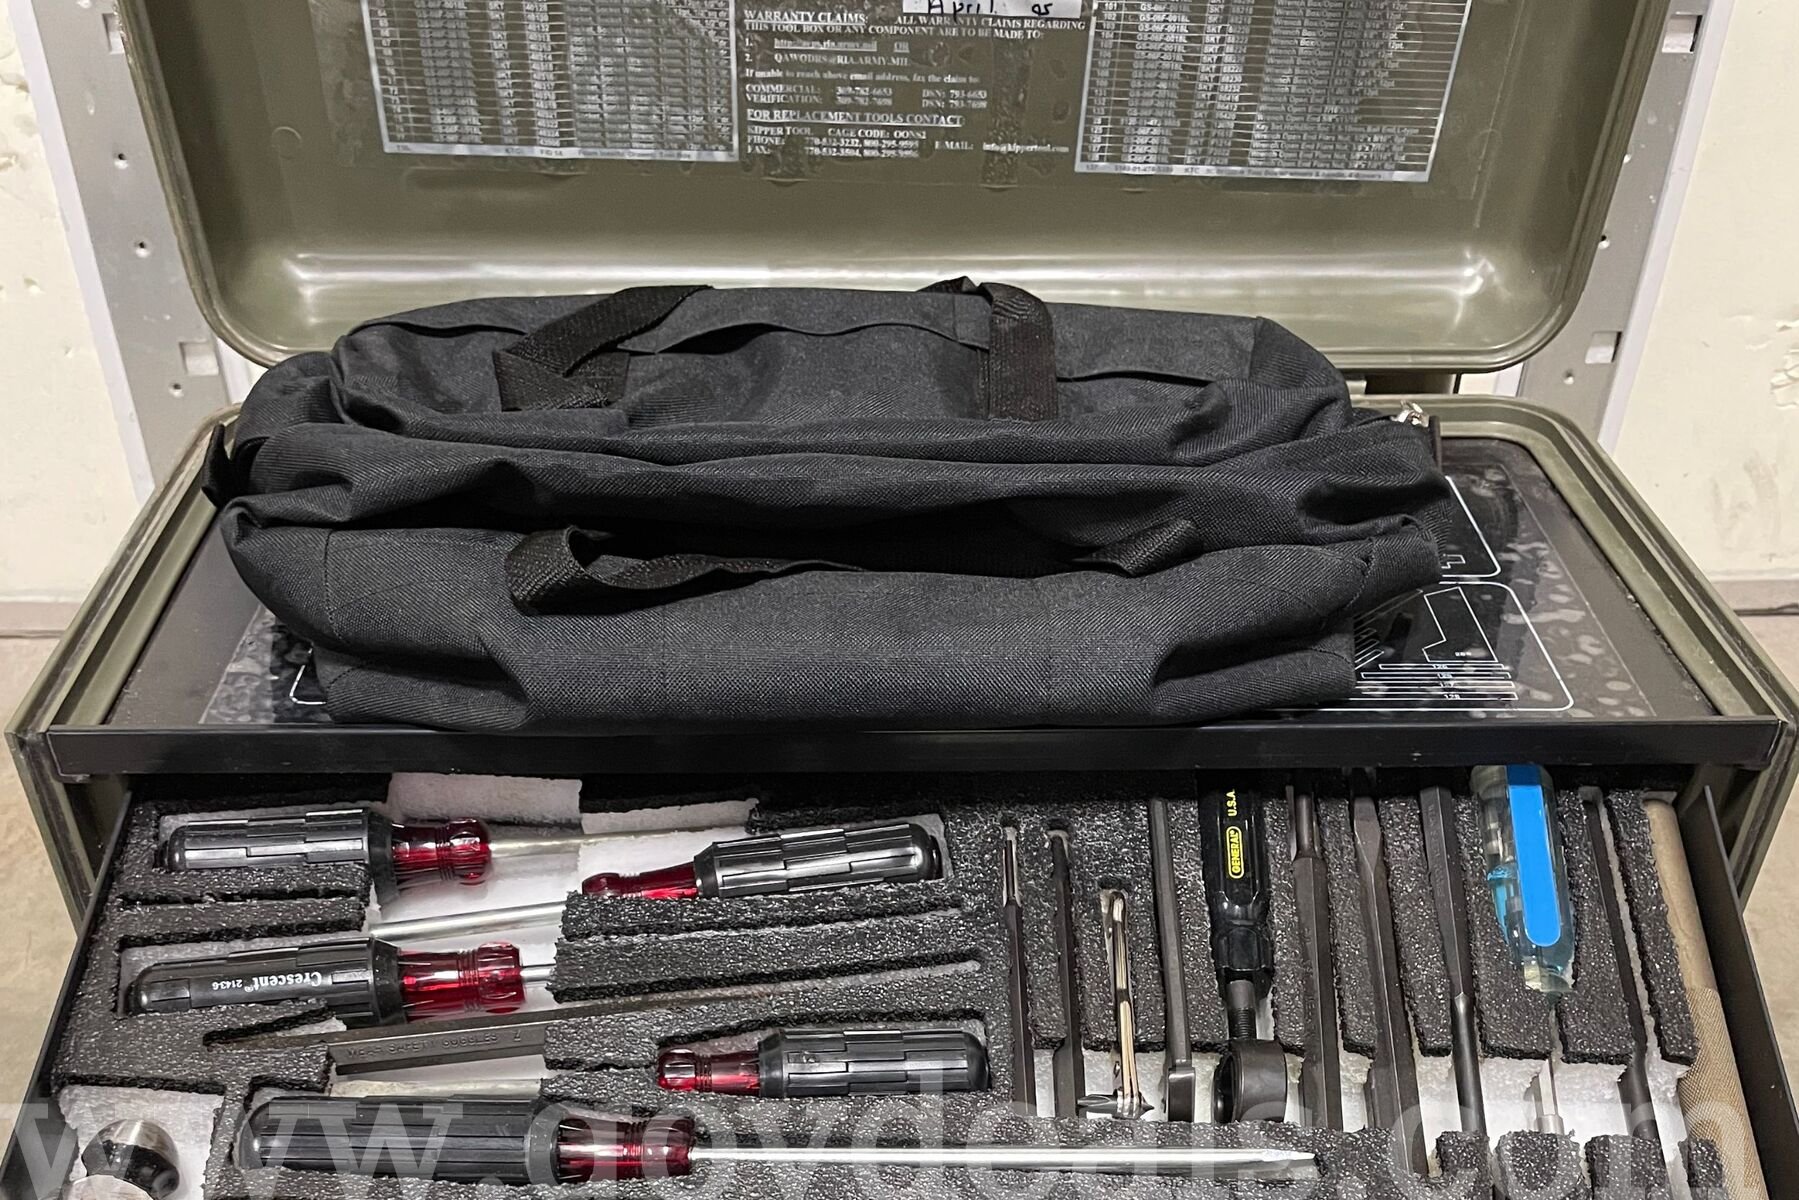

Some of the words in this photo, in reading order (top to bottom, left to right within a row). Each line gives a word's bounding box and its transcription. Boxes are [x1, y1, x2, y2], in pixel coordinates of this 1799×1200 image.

[744, 9, 815, 22] WARRANTY
[818, 12, 868, 24] CLAIMS:
[895, 15, 916, 25] ALL
[981, 17, 1021, 28] CLAIMS
[1024, 19, 1086, 30] REGARDING
[745, 22, 769, 31] THIS
[772, 22, 801, 32] TOOL
[803, 23, 824, 33] BOX
[826, 24, 842, 33] OR
[844, 25, 866, 33] ANY
[868, 25, 936, 36] COMPONENT
[939, 27, 959, 37] ARE
[961, 27, 976, 37] TO
[993, 28, 1024, 39] MADE
[747, 108, 771, 121] FOR
[772, 109, 863, 124] REPLACEMENT
[864, 112, 904, 124] TOOLS
[785, 126, 814, 136] TOOL
[828, 128, 856, 138] CAGE
[1230, 831, 1241, 874] GENERAL
[252, 971, 322, 991] Crescent
[443, 1033, 499, 1049] GOGGLES
